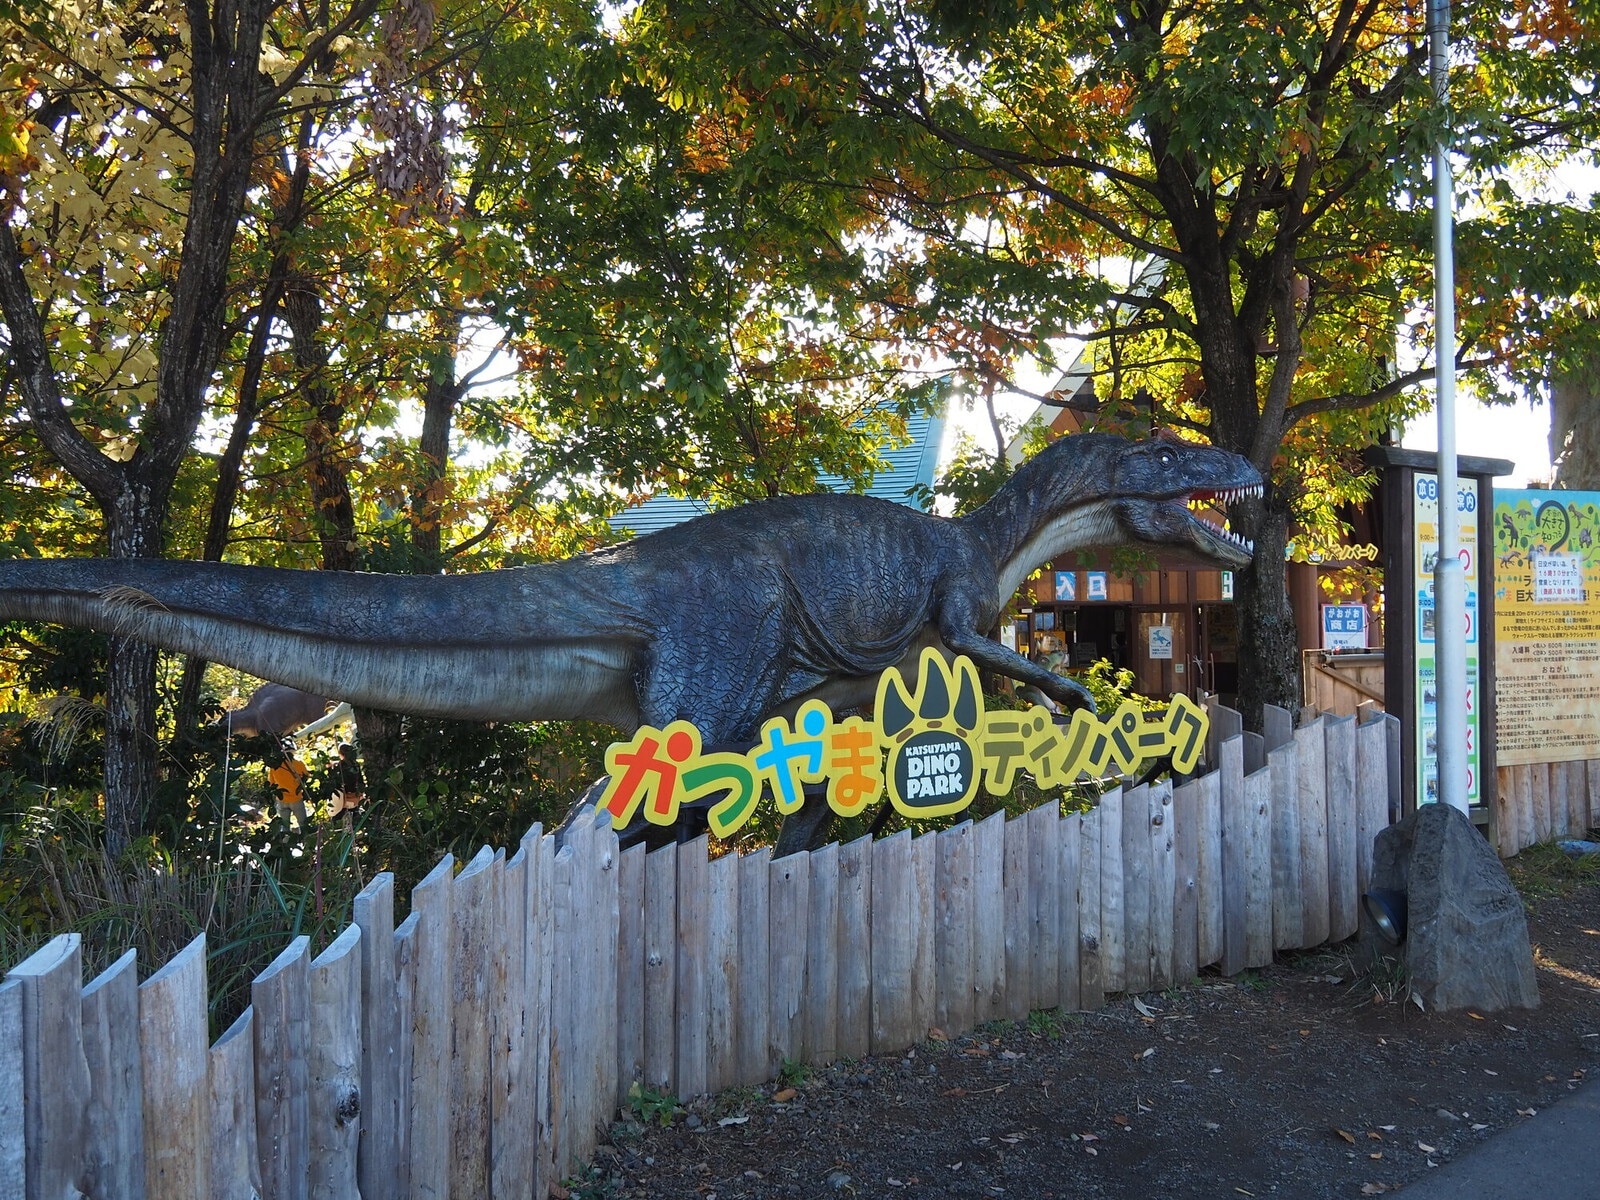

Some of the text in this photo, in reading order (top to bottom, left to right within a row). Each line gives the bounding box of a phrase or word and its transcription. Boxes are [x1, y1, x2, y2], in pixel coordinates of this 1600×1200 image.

[1541, 517, 1565, 531] 大きさ
[1056, 575, 1106, 600] 入口
[1328, 608, 1360, 619] がおがお
[1330, 620, 1358, 631] 商店
[1542, 665, 1569, 673] おねがい
[905, 741, 961, 757] KATSUYAMA
[984, 703, 1202, 784] ディノパーク
[607, 709, 878, 827] かつやま
[908, 753, 961, 778] DINO
[906, 773, 963, 800] PARK
